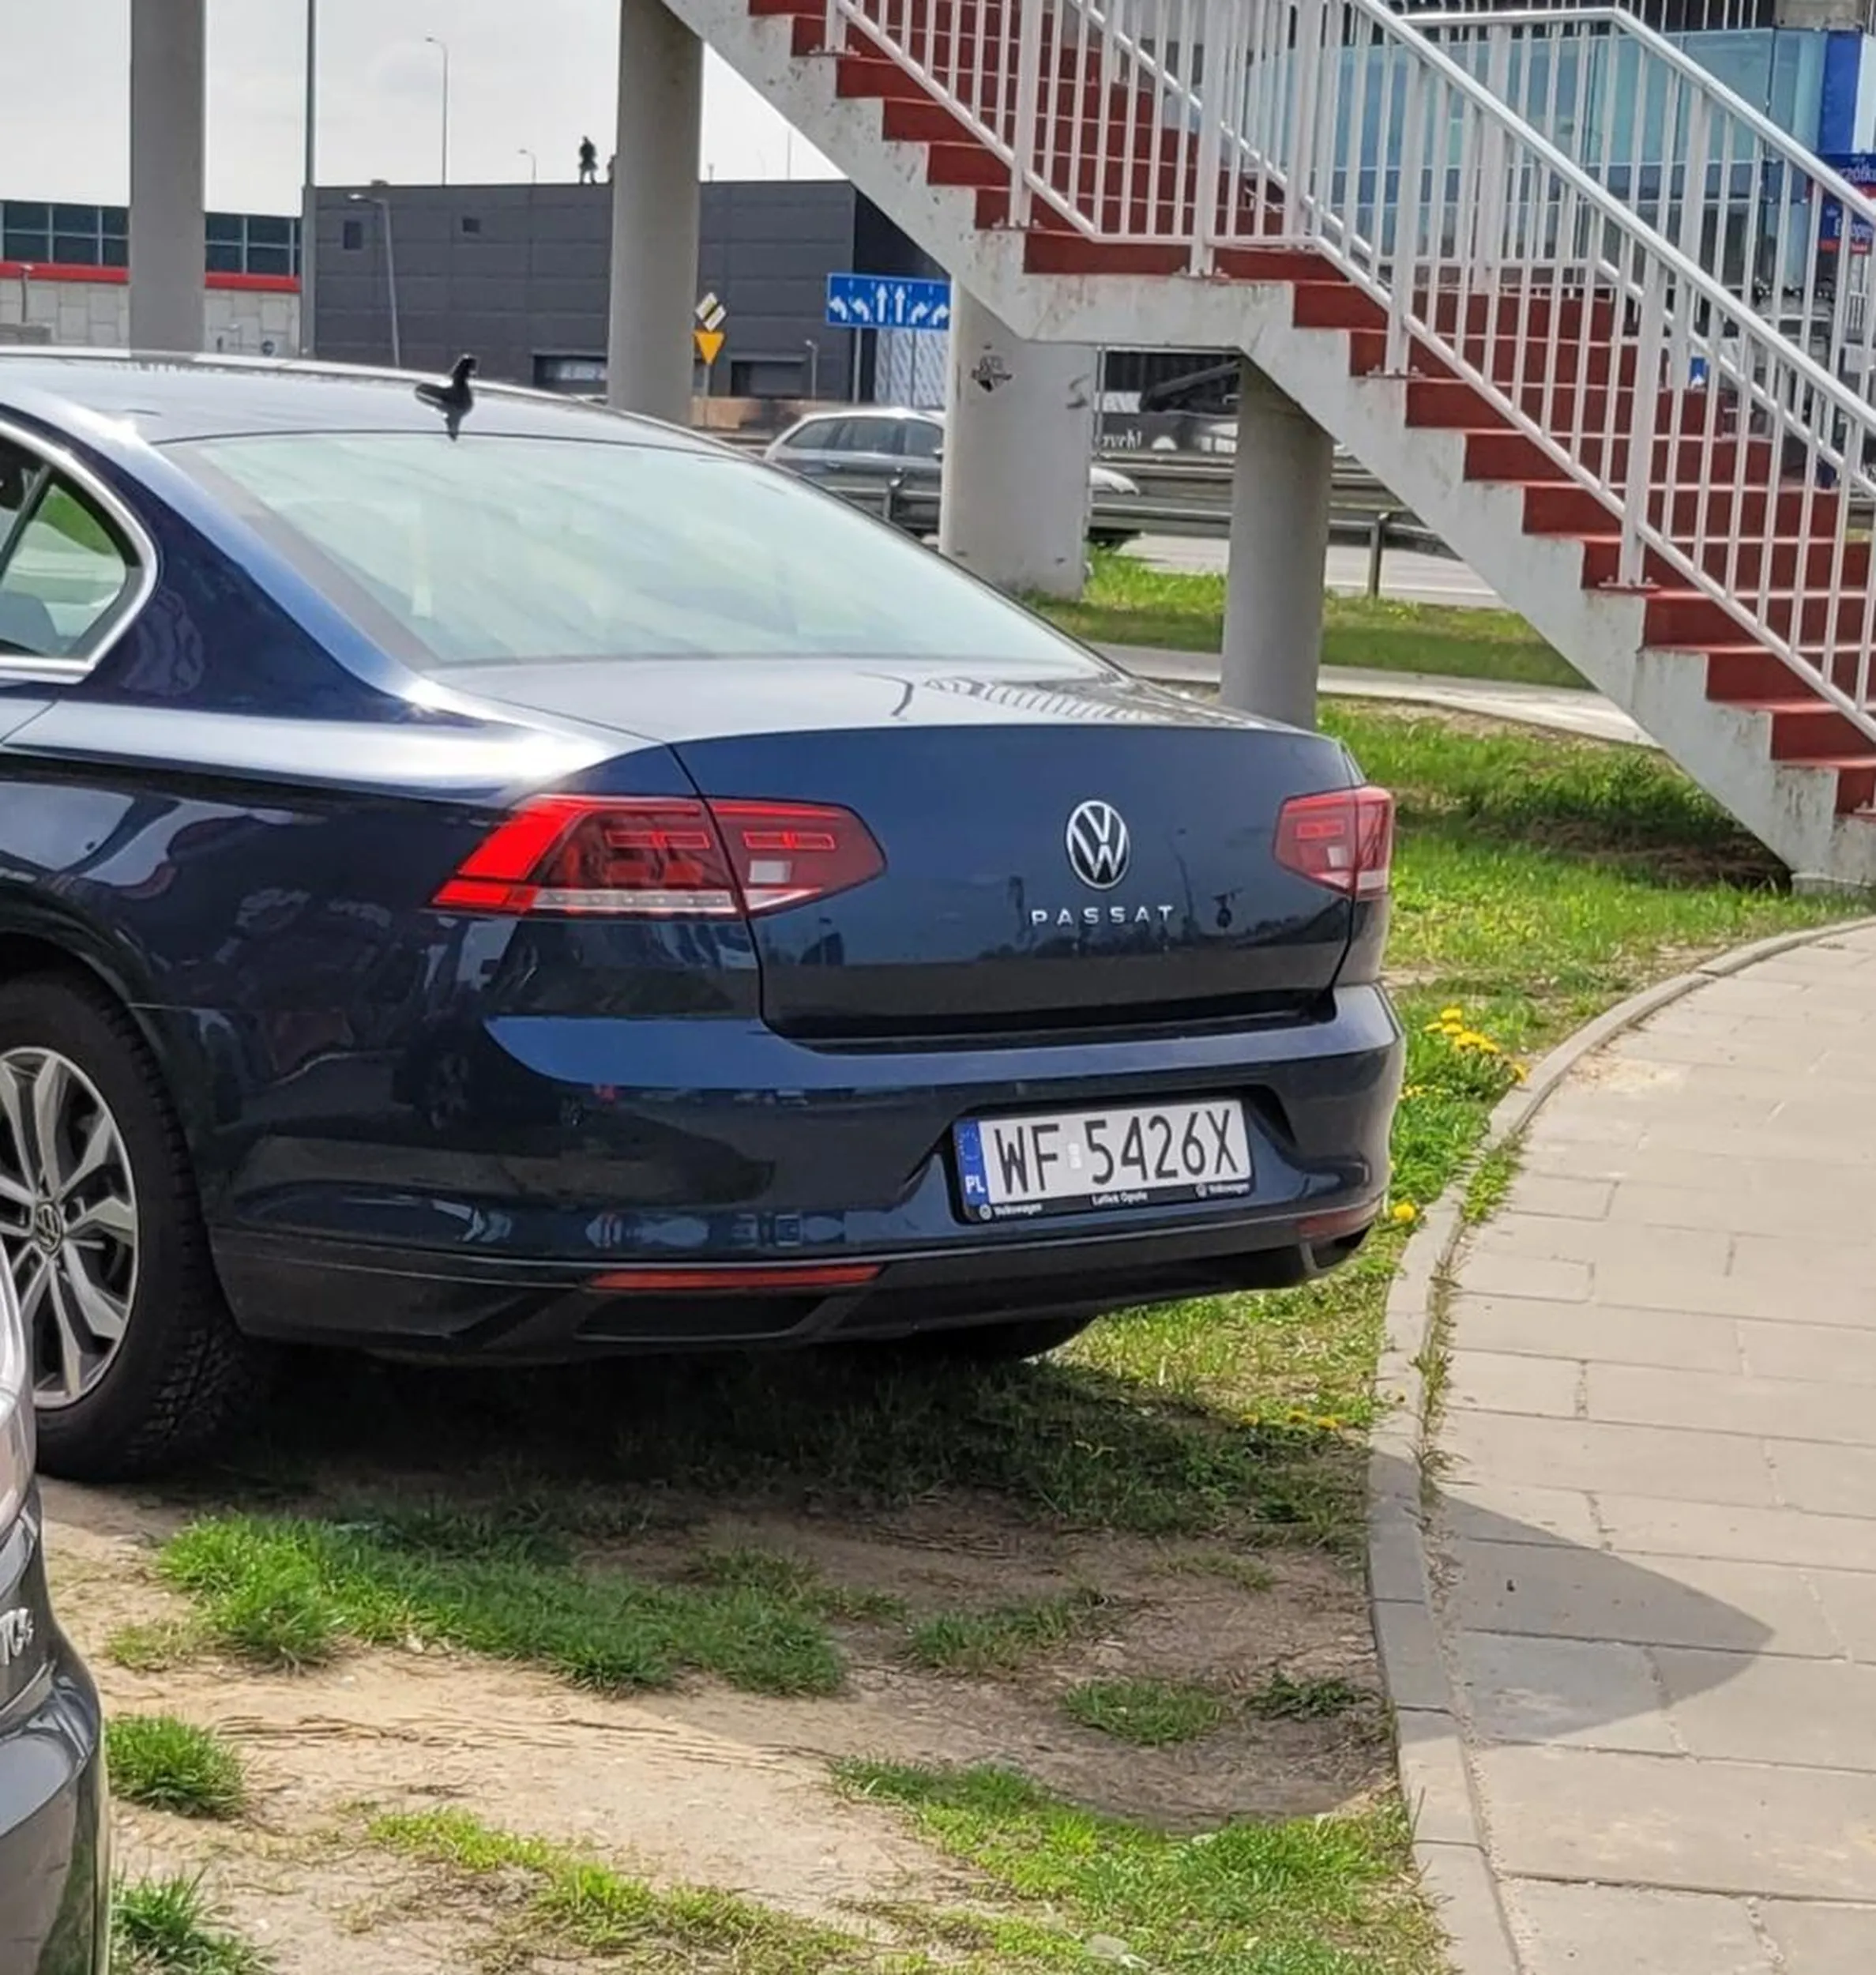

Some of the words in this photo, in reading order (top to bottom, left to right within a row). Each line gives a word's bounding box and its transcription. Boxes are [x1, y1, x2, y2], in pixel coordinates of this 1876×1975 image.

[1031, 905, 1173, 925] PASSAT
[994, 1123, 1059, 1194] WF
[1084, 1108, 1238, 1185] 5426X
[965, 1175, 986, 1194] PL
